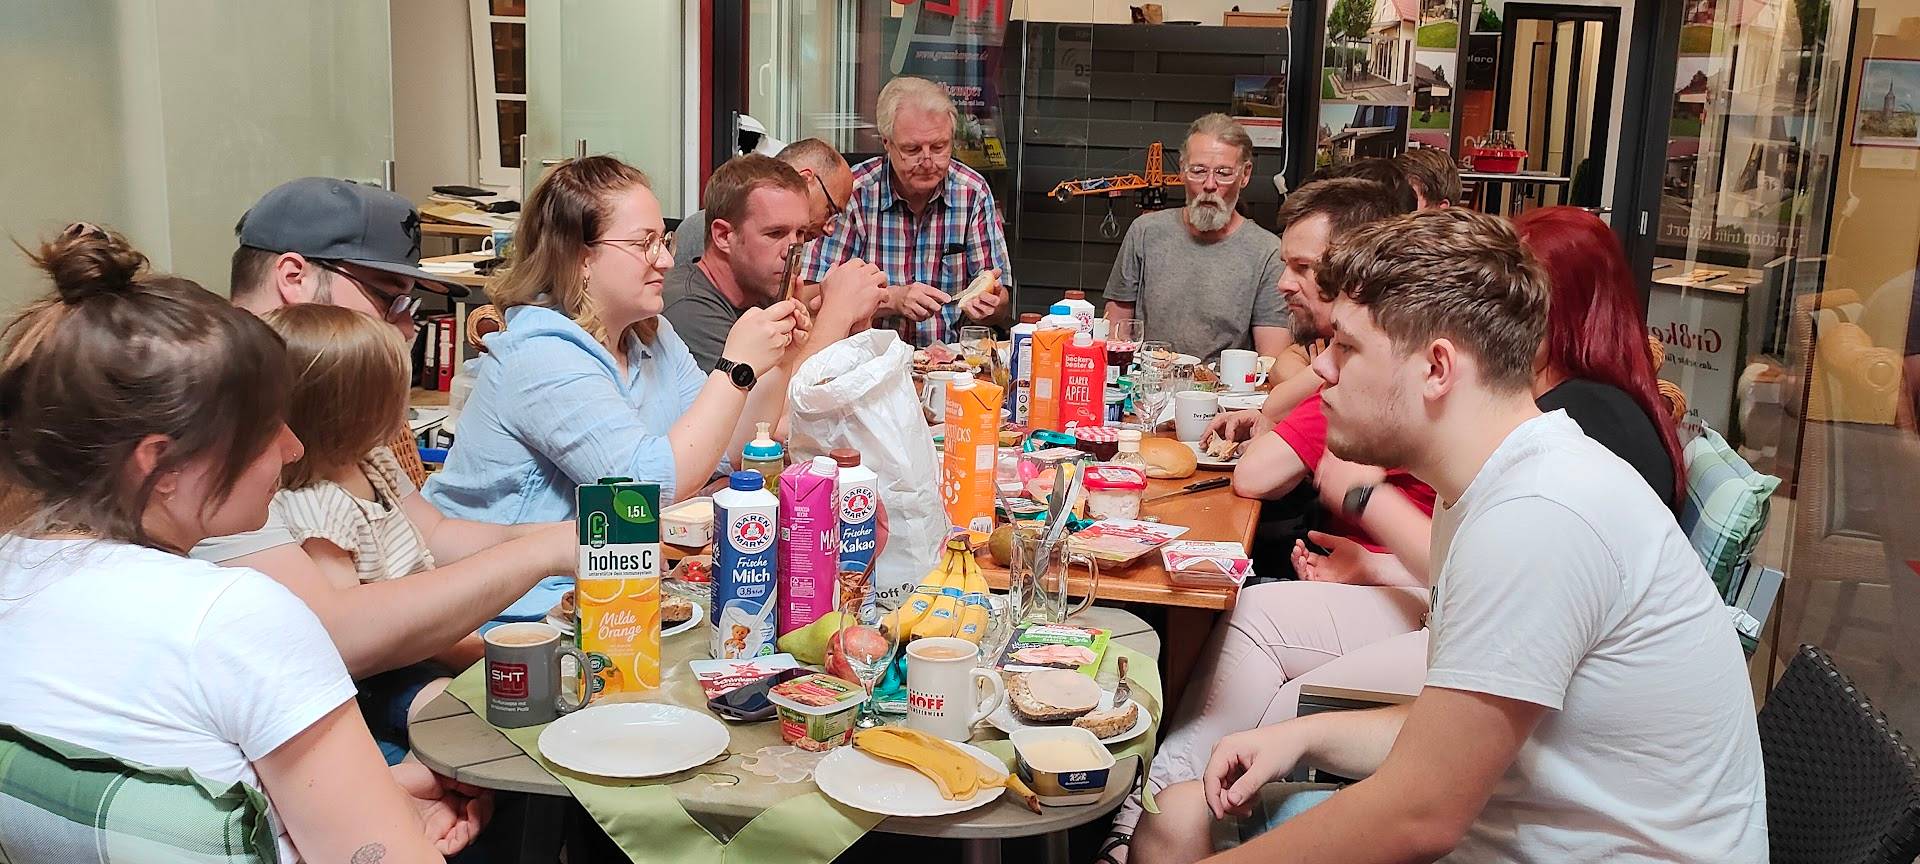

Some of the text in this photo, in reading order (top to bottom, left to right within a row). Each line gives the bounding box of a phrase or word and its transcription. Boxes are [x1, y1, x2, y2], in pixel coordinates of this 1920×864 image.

[1468, 54, 1494, 64] lero
[1068, 376, 1089, 386] KLARER
[1065, 385, 1091, 402] APFEL
[843, 505, 873, 518] MARKE
[842, 525, 873, 539] Frischer
[735, 533, 770, 547] MARKE
[840, 538, 875, 553] Kakao
[588, 550, 652, 570] hohes C
[737, 555, 768, 569] Frische
[732, 568, 771, 584] Milch
[600, 609, 637, 627] Milde
[598, 624, 643, 642] Orange
[491, 669, 525, 682] SHT
